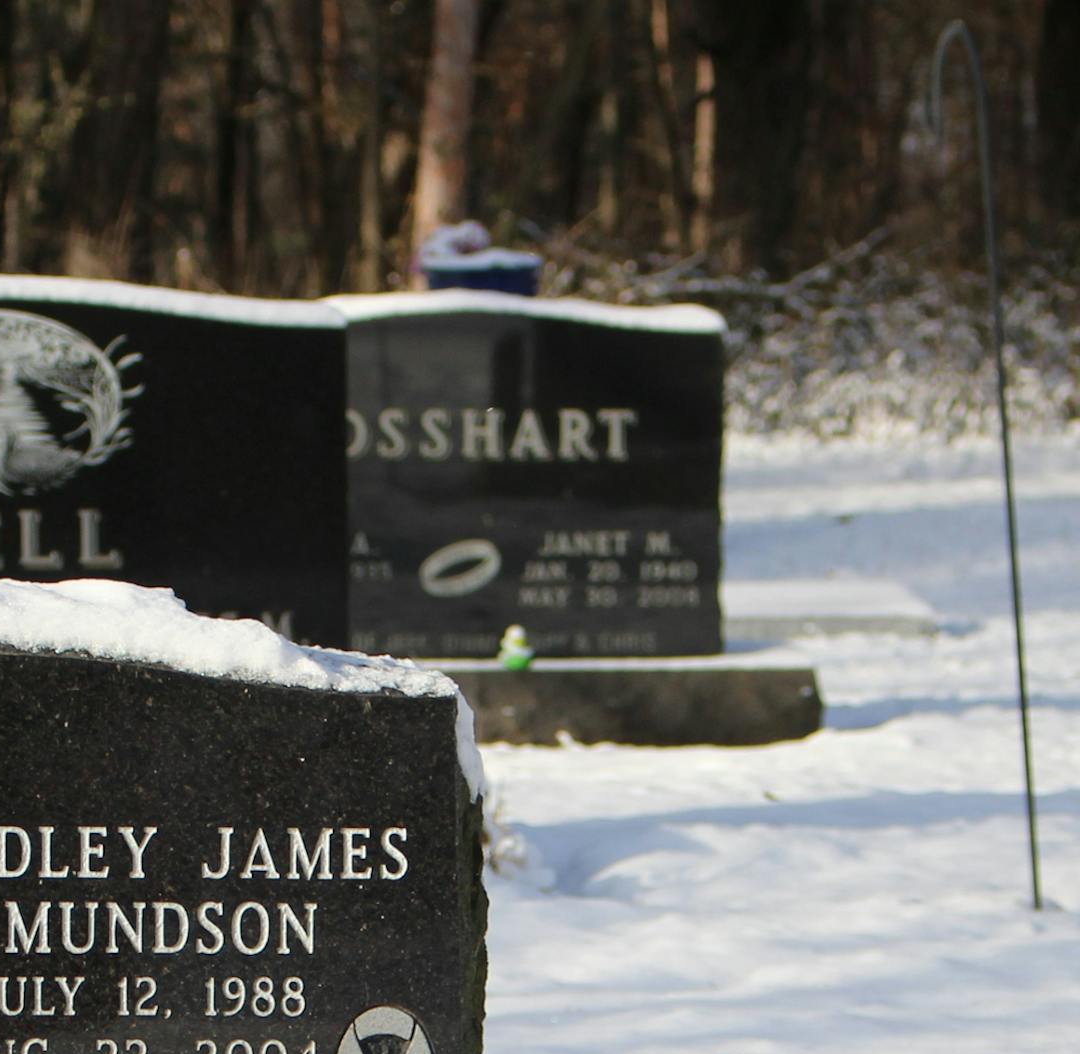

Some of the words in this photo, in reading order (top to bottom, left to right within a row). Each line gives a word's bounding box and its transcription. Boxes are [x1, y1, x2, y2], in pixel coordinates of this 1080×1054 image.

[346, 407, 638, 461] OSSHART
[537, 531, 631, 556] JANET
[645, 531, 681, 556] M.
[518, 585, 571, 608] MAY
[201, 826, 410, 881] JAMES
[117, 976, 173, 1020] 12,
[205, 976, 307, 1017] 1988
